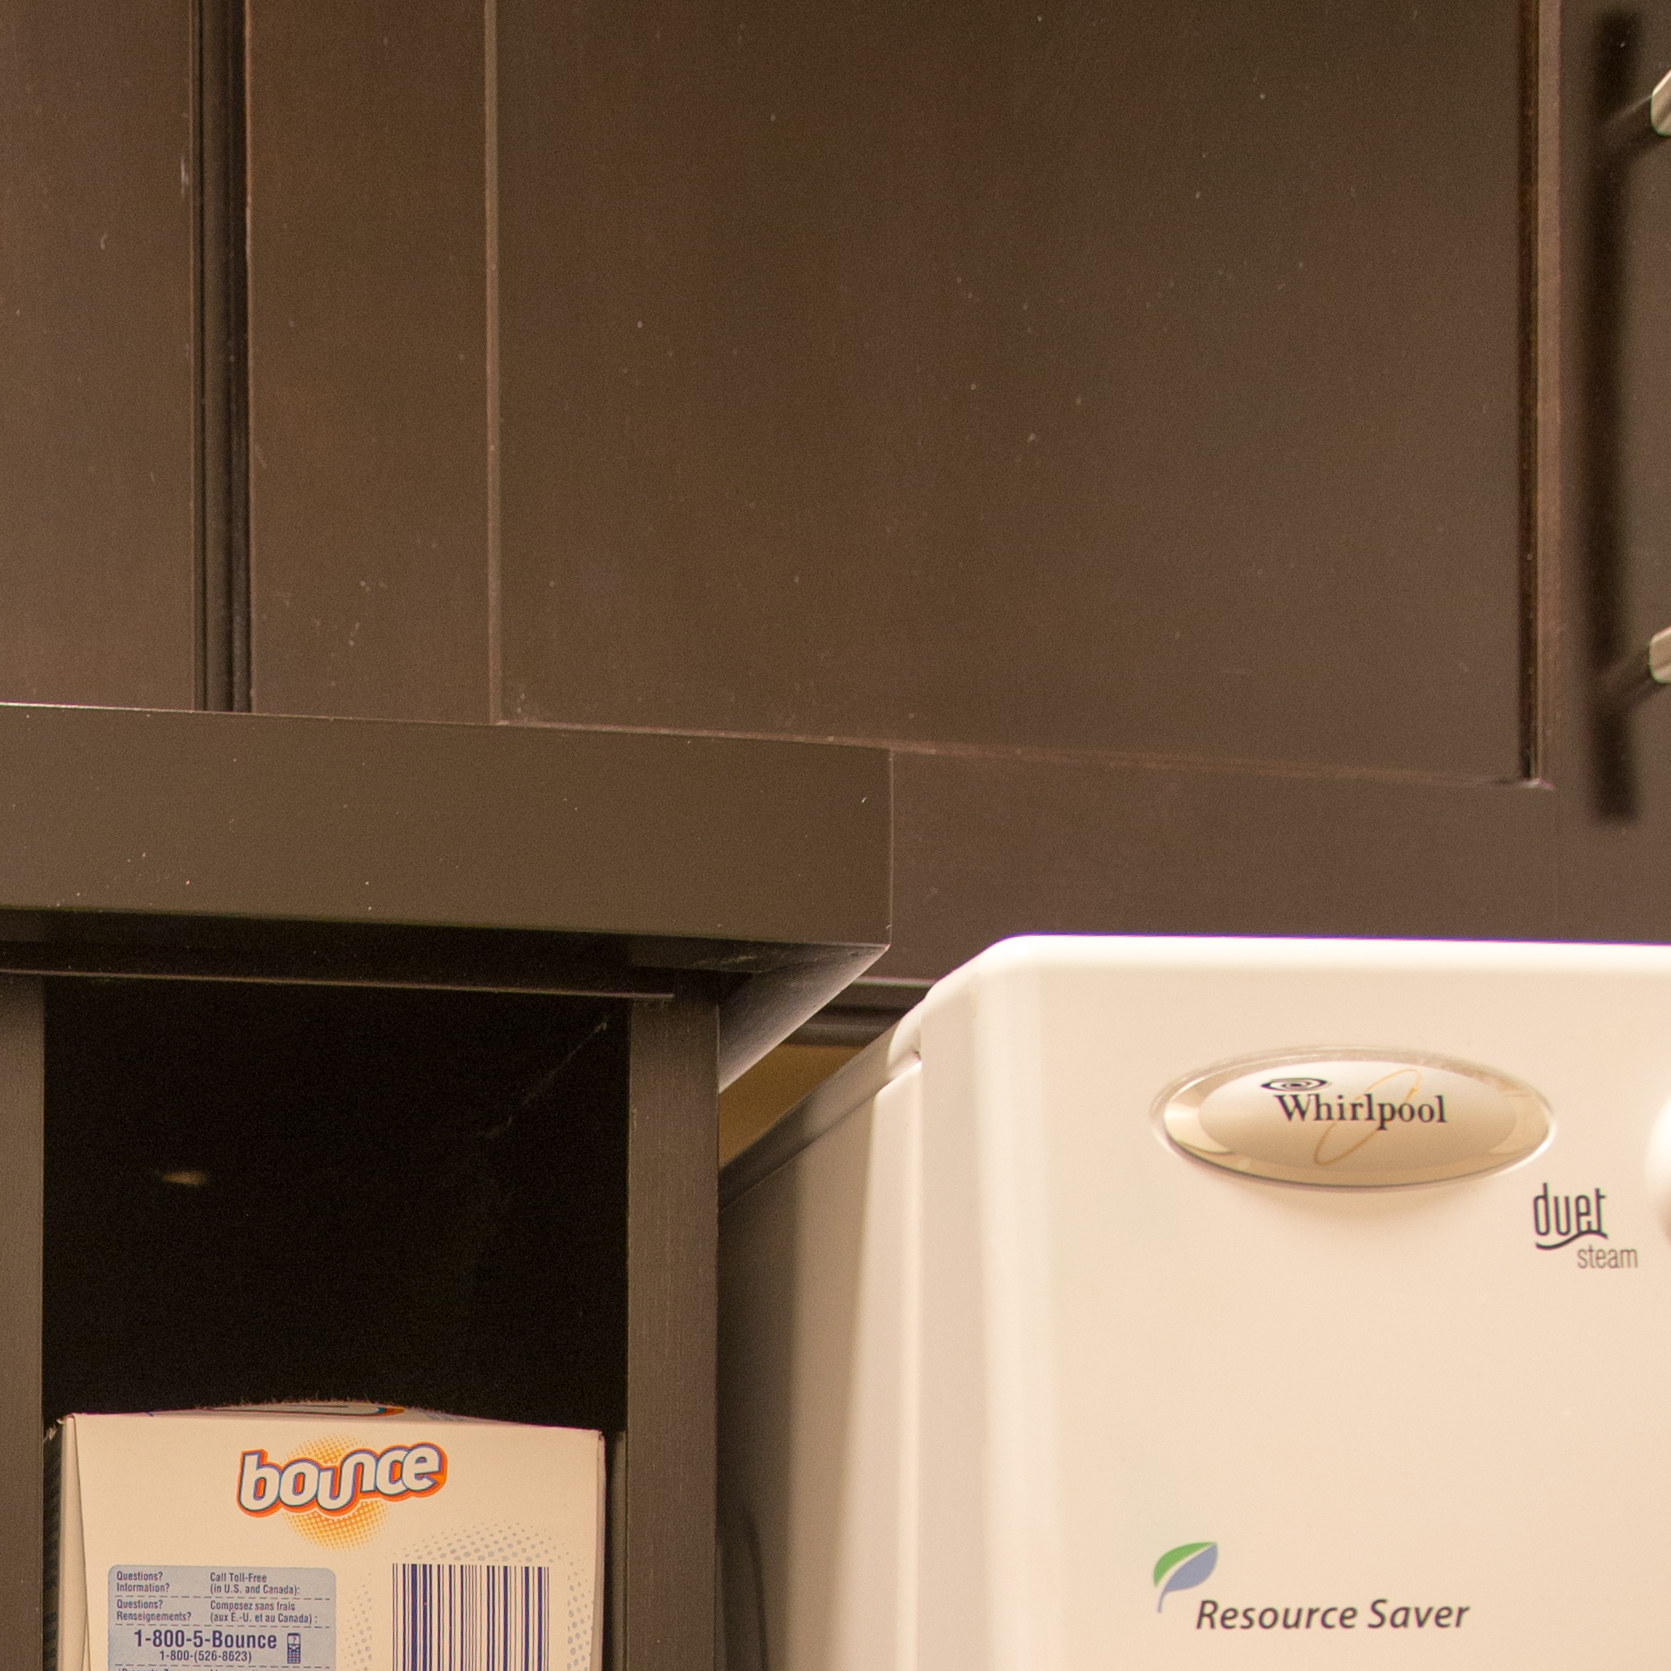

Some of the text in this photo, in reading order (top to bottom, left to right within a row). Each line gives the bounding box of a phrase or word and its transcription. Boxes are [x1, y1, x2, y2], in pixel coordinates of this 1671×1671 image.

[1274, 1093, 1447, 1131] Whirlpool
[1533, 1182, 1608, 1238] duet
[1577, 1245, 1639, 1269] steam
[238, 1444, 446, 1516] bounce
[116, 1570, 164, 1582] Questions?
[210, 1571, 267, 1583] Call Toll-Free
[116, 1582, 170, 1593] Information?
[210, 1584, 301, 1596] (in U.S. and Canada):
[116, 1599, 164, 1610] Questions?
[210, 1600, 296, 1612] Composez sans frais
[116, 1611, 192, 1623] Renseignements?
[210, 1612, 229, 1624] (aux
[254, 1613, 264, 1623] et
[265, 1614, 276, 1624] au
[1195, 1598, 1471, 1630] Resource Saver
[133, 1629, 278, 1650] 1-800-5-Bounce
[158, 1650, 253, 1663] 1-800-(526-8623)
